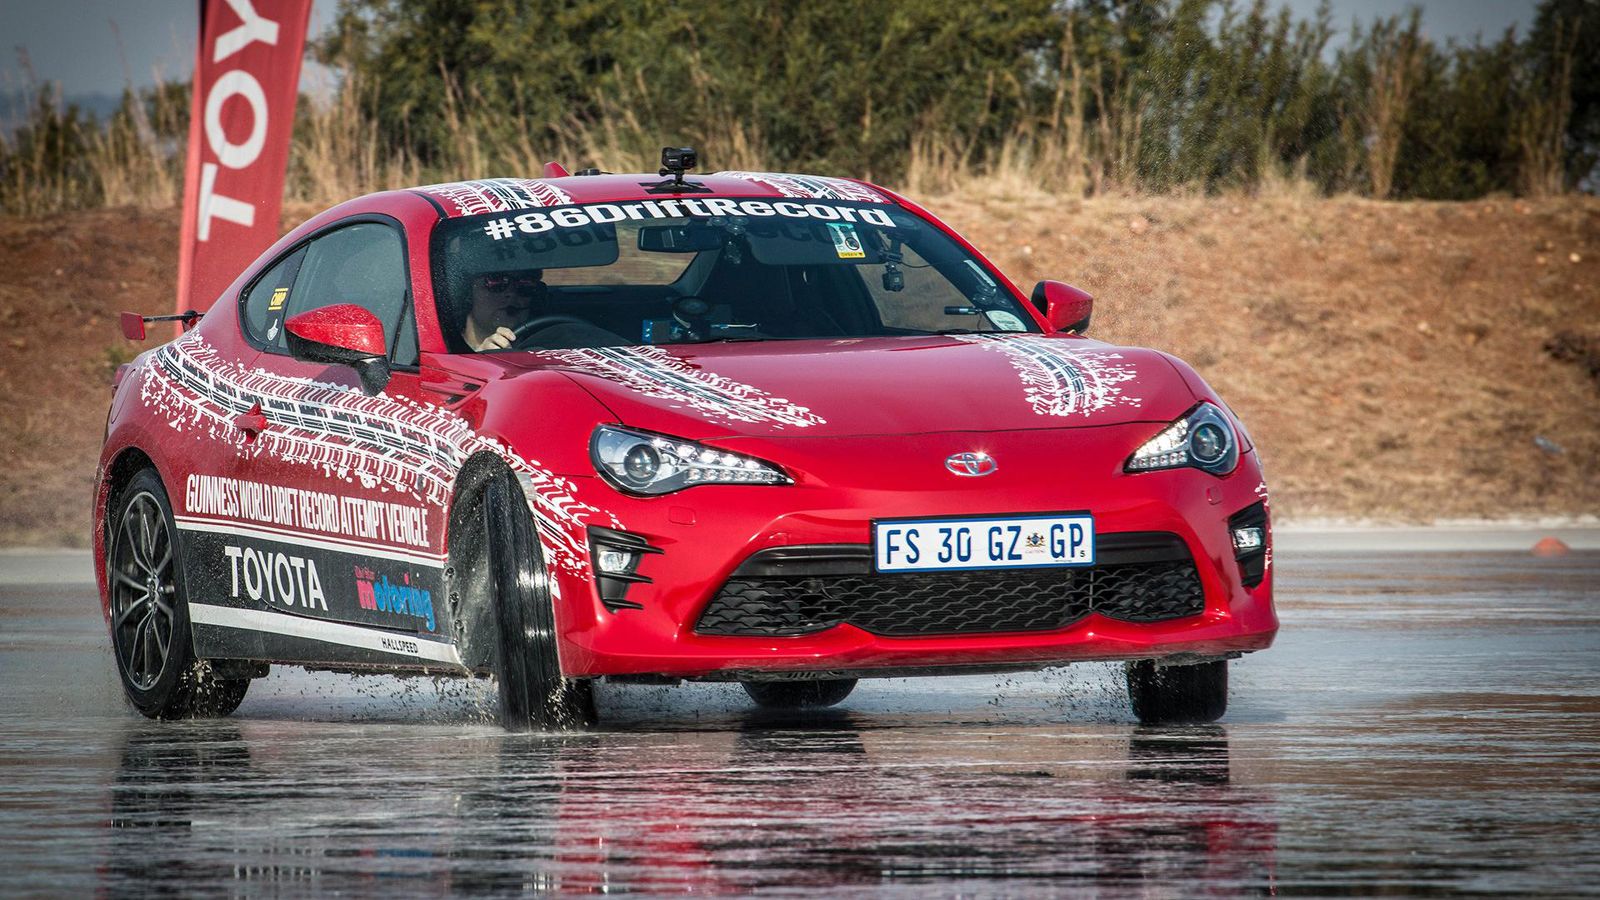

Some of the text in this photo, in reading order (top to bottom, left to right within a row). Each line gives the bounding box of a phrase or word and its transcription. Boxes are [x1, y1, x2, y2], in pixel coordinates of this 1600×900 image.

[197, 0, 279, 241] TOY
[484, 199, 897, 240] #86DriftRecord
[186, 474, 430, 547] GUINNESS WORLD DRIFT RECORD ATTEMPT VEHICLE
[887, 523, 1083, 564] FS 30 GZ GP
[225, 546, 329, 611] TOYOTA
[381, 638, 418, 654] HALLSPEED
